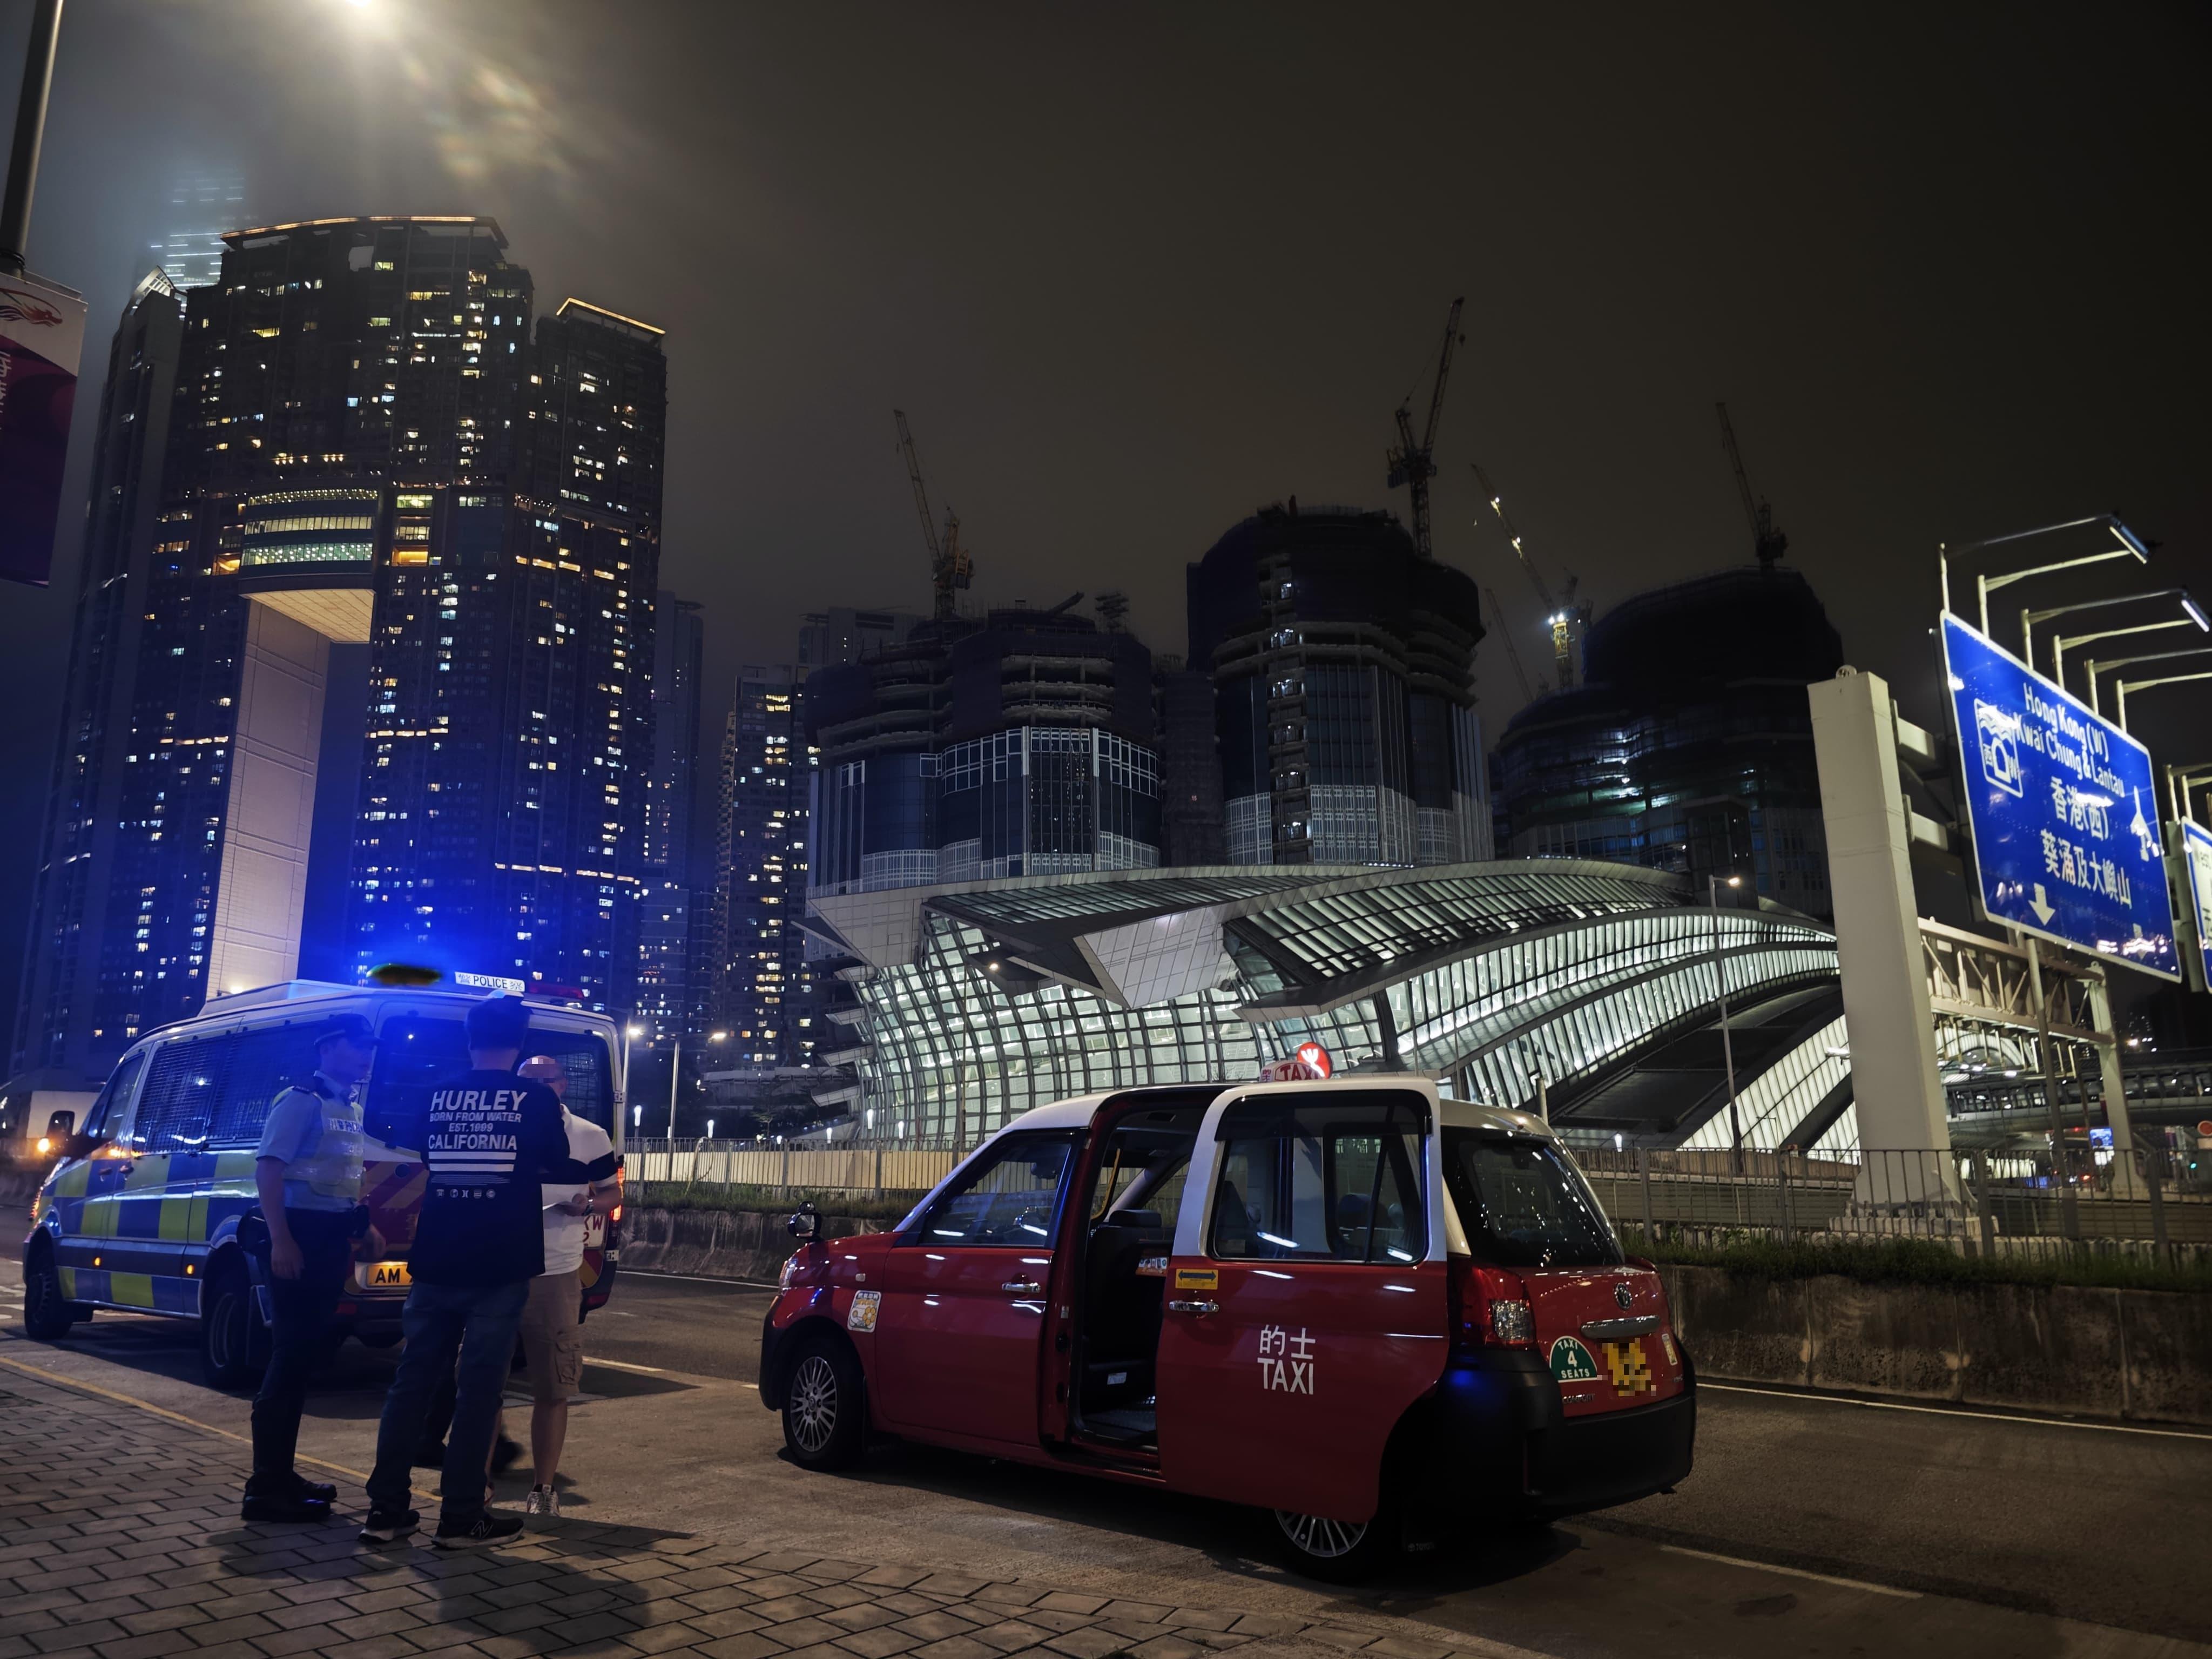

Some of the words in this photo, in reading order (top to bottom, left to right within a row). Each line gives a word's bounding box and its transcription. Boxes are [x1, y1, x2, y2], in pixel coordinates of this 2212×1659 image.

[2024, 683, 2058, 733] Hong
[2056, 704, 2087, 751] Kong
[2087, 723, 2109, 763] (W)
[2013, 712, 2045, 753] Kwai
[2046, 730, 2083, 780] Chung
[2082, 750, 2092, 779] &
[2090, 756, 2125, 798] Lantau
[2051, 776, 2108, 841] 香港(西)
[2040, 829, 2132, 909] 葵涌及大嶼山
[473, 975, 508, 989] POLICE
[430, 1090, 528, 1111] HURLEY
[429, 1112, 454, 1122] BORN
[456, 1112, 484, 1122] FROM
[487, 1112, 522, 1123] WATER
[428, 1134, 517, 1150] CALIFORNIA
[375, 1268, 400, 1284] AM
[1259, 1324, 1316, 1360] 的士
[1557, 1339, 1578, 1350] TAXI
[1567, 1350, 1577, 1367] 4
[1257, 1357, 1314, 1395] TAXI
[1560, 1368, 1590, 1379] SEATS
